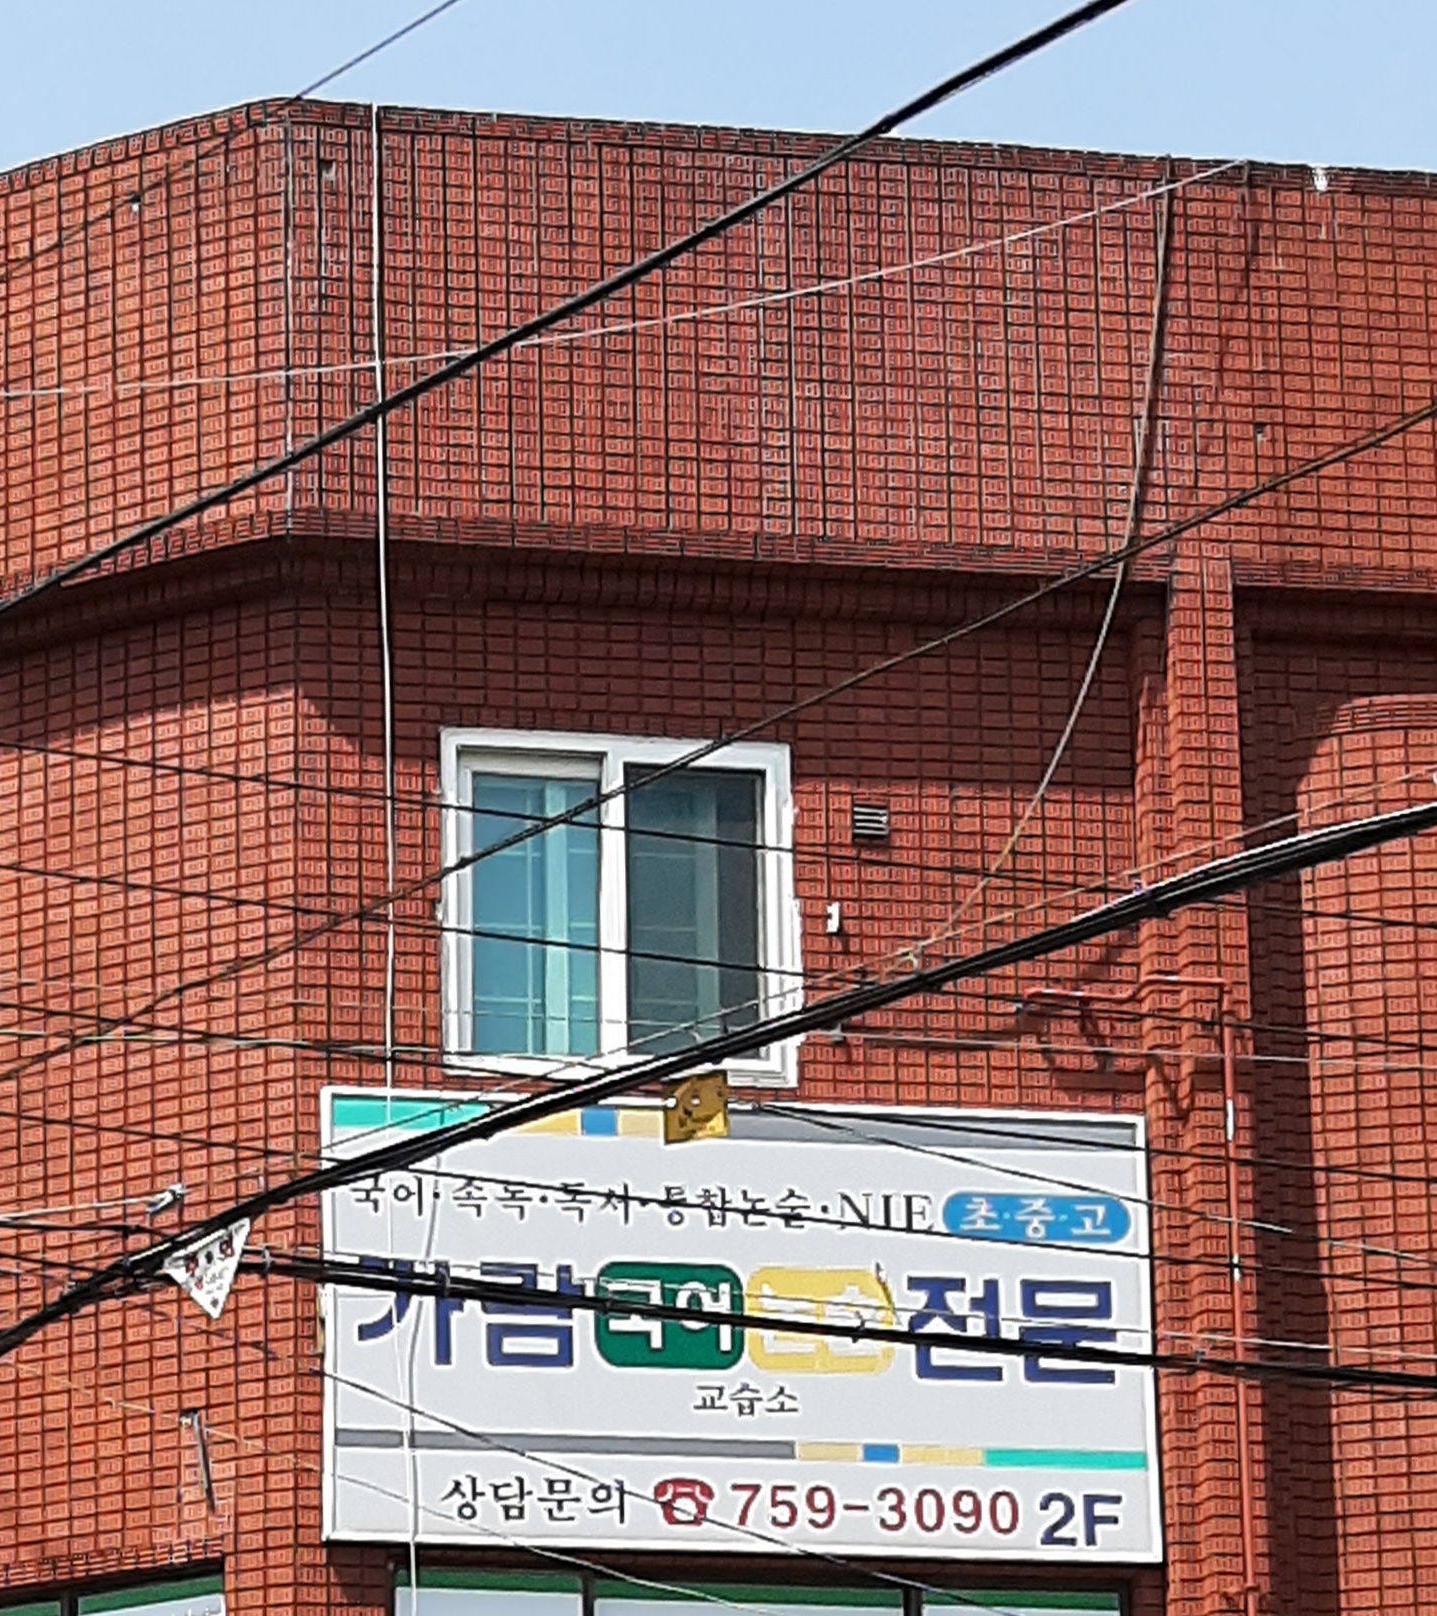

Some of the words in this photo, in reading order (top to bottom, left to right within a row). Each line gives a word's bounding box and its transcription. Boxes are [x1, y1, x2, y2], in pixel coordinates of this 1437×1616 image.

[357, 1258, 593, 1367] 가람
[605, 1279, 734, 1353] 국어
[907, 1276, 1119, 1383] 전문
[693, 1384, 799, 1416] 교습소
[440, 1474, 629, 1525] 상담문의
[730, 1483, 1020, 1535] 759-3090
[1038, 1491, 1123, 1547] 2F
